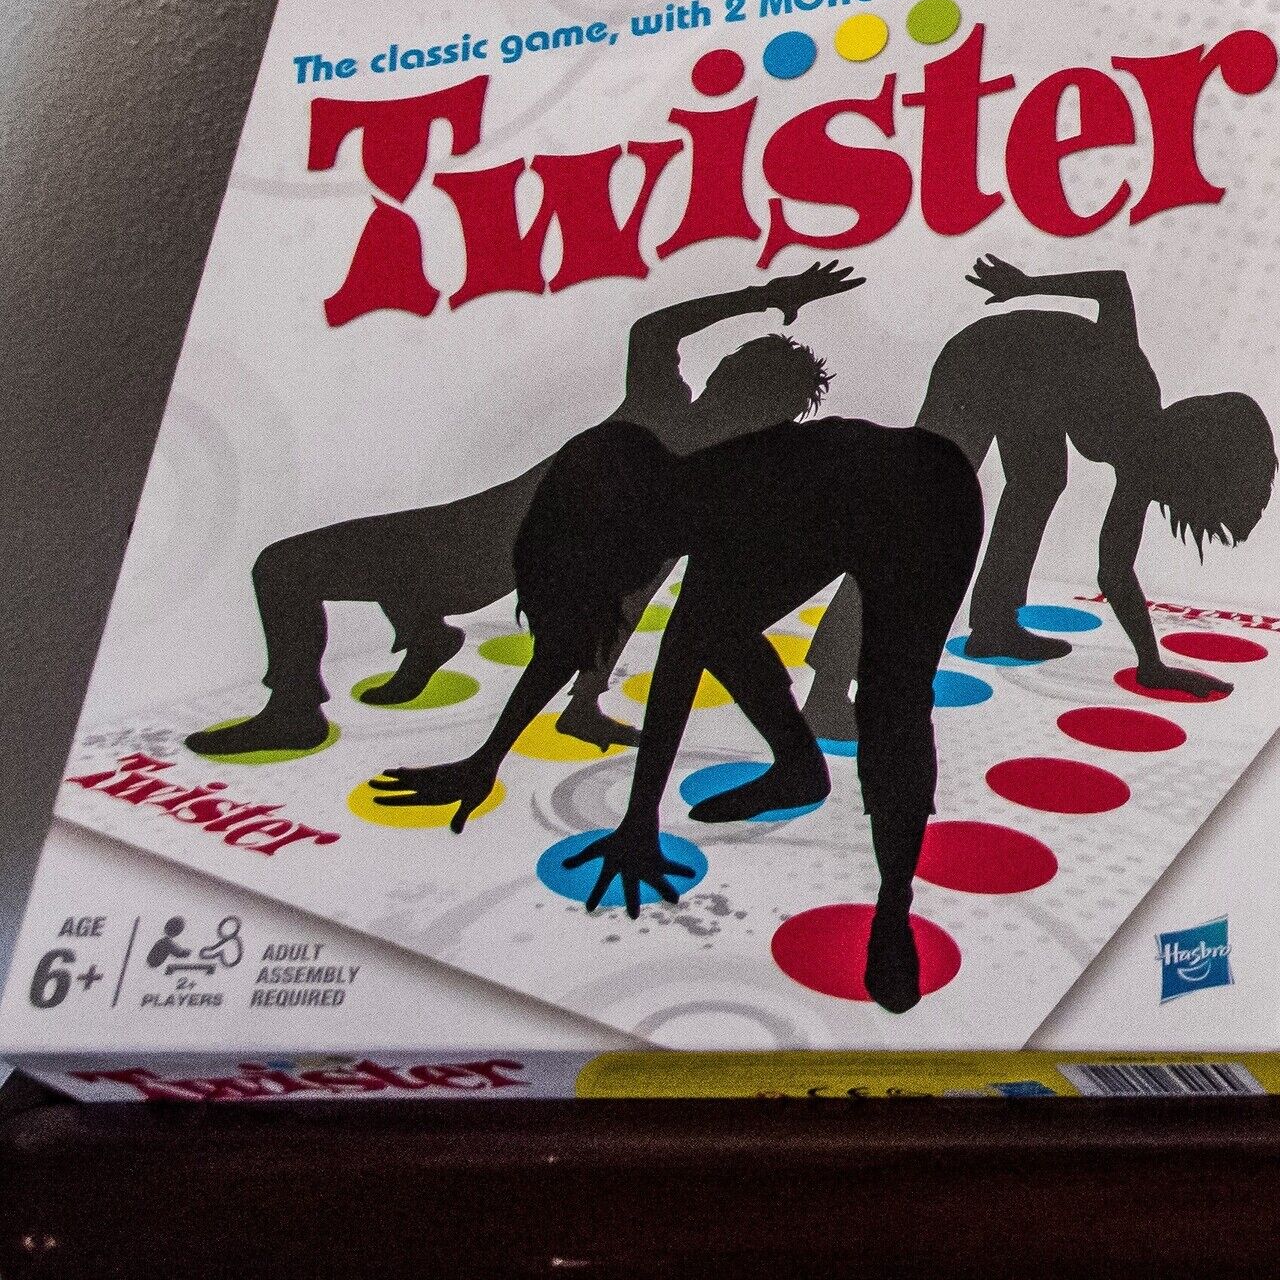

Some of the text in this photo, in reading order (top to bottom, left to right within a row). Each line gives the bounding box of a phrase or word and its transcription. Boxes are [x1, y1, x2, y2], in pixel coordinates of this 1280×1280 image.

[292, 53, 357, 84] The
[369, 32, 487, 73] classic
[499, 21, 618, 63] game,
[629, 0, 711, 37] with
[306, 20, 1279, 328] Twister
[64, 753, 341, 857] Twister
[58, 916, 104, 938] AGE
[262, 943, 325, 961] ADULT
[1159, 940, 1234, 968] Hasbro
[28, 948, 104, 1009] 6+
[256, 965, 360, 984] ASSEMBLY
[140, 992, 224, 1008] PLAYERS
[249, 988, 346, 1008] REQUIRED
[68, 1056, 532, 1102] Twister
